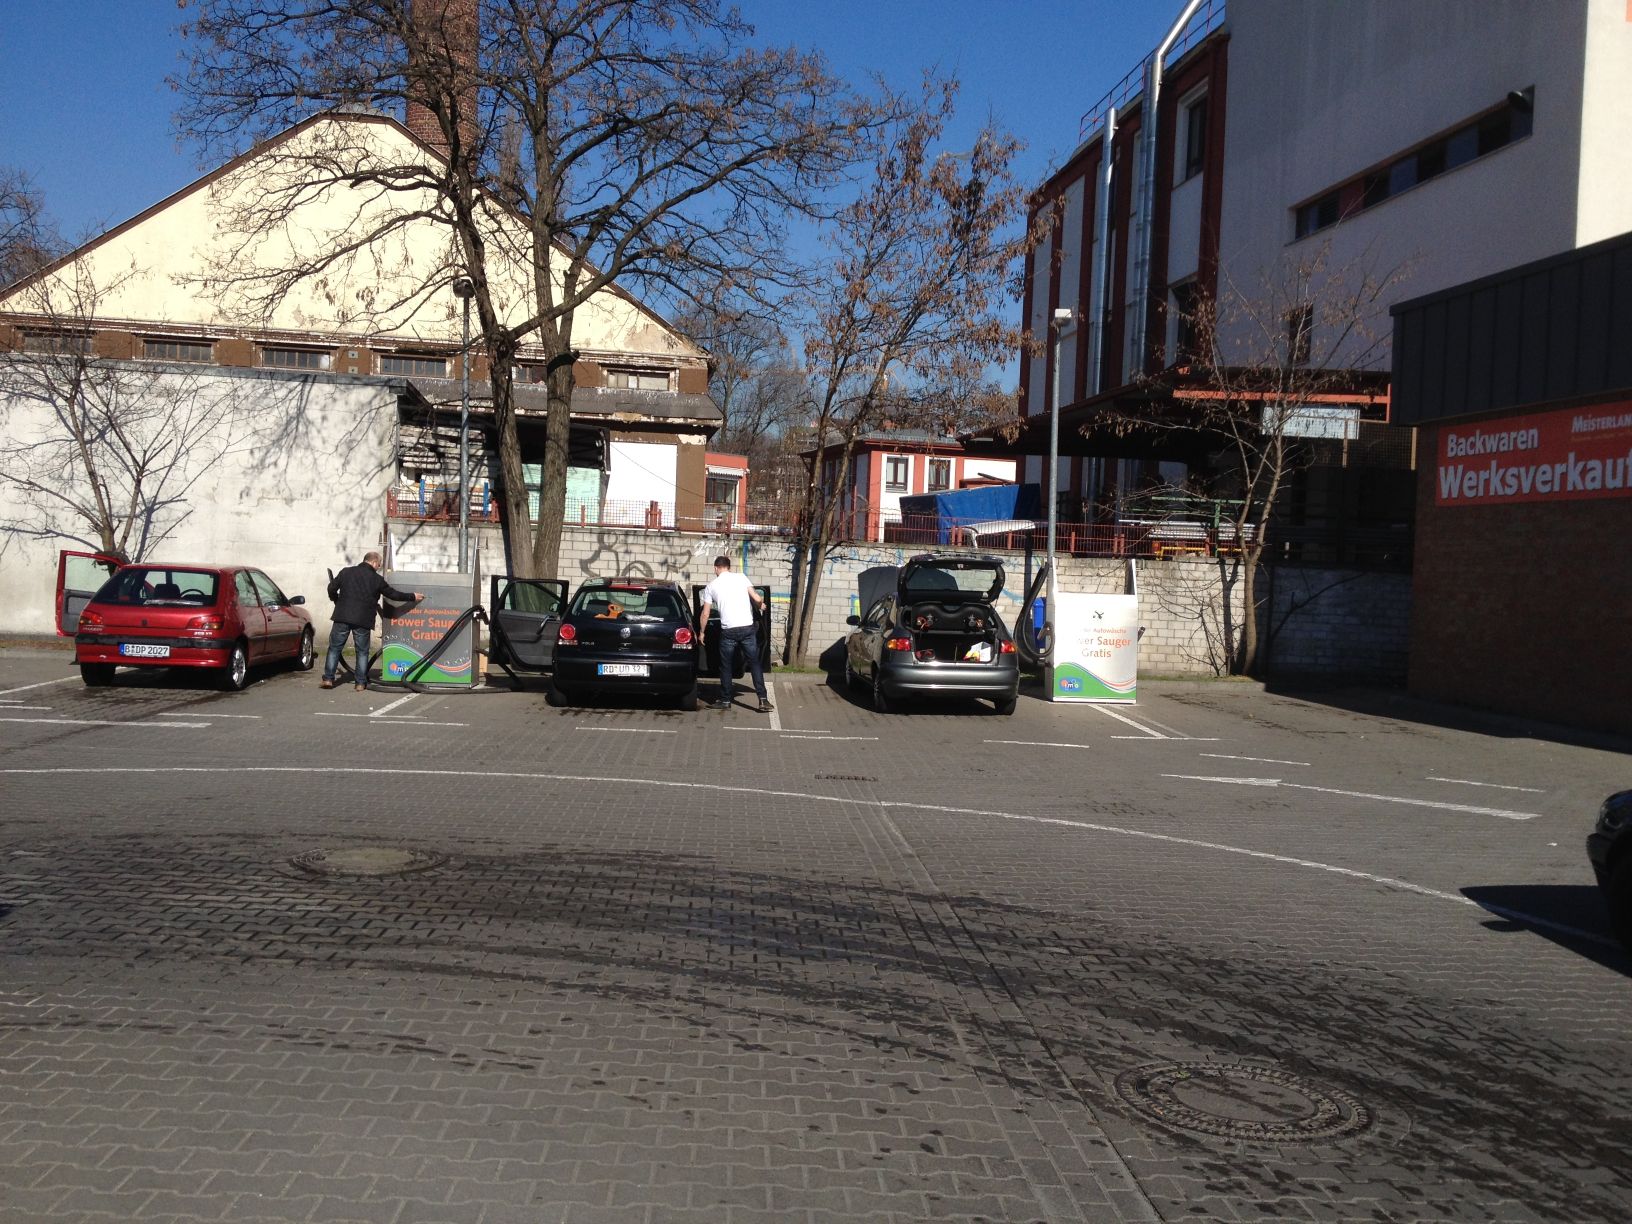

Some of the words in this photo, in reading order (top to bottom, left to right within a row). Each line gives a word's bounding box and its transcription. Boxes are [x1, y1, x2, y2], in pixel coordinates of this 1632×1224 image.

[1447, 427, 1539, 458] Backwaren
[391, 617, 425, 627] Power
[428, 617, 456, 631] Saug
[411, 630, 444, 641] Gratis
[1097, 636, 1132, 649] Sauger
[136, 645, 147, 655] DP
[147, 646, 169, 655] 2027
[1081, 648, 1112, 658] Gratis
